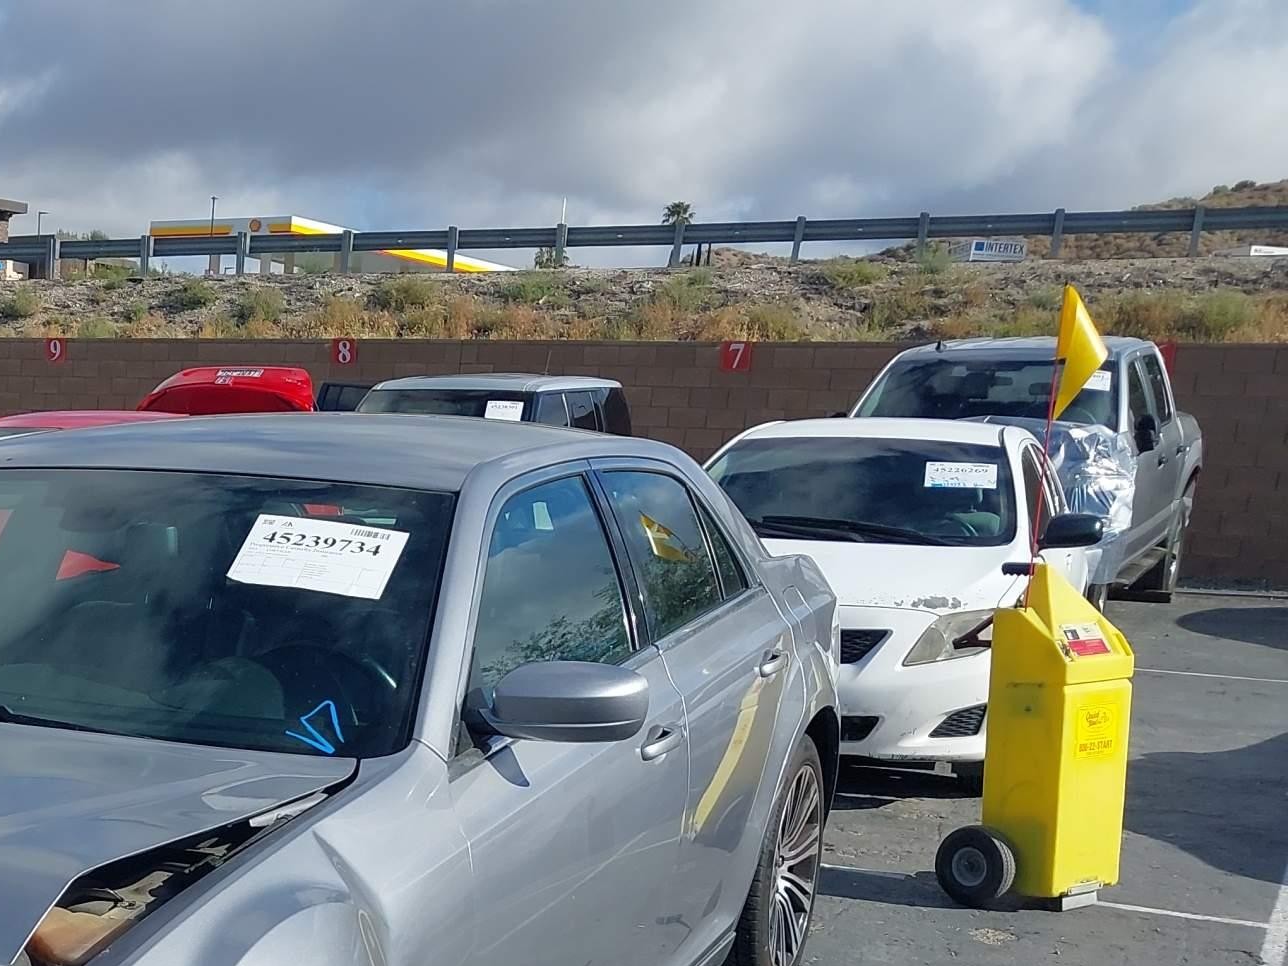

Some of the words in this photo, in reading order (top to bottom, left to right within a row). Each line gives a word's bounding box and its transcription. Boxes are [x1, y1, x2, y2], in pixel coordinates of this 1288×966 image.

[985, 240, 1025, 255] INTERTEX
[49, 339, 61, 361] 9
[338, 340, 351, 364] 8
[728, 343, 745, 369] 7
[263, 531, 382, 557] 45239734
